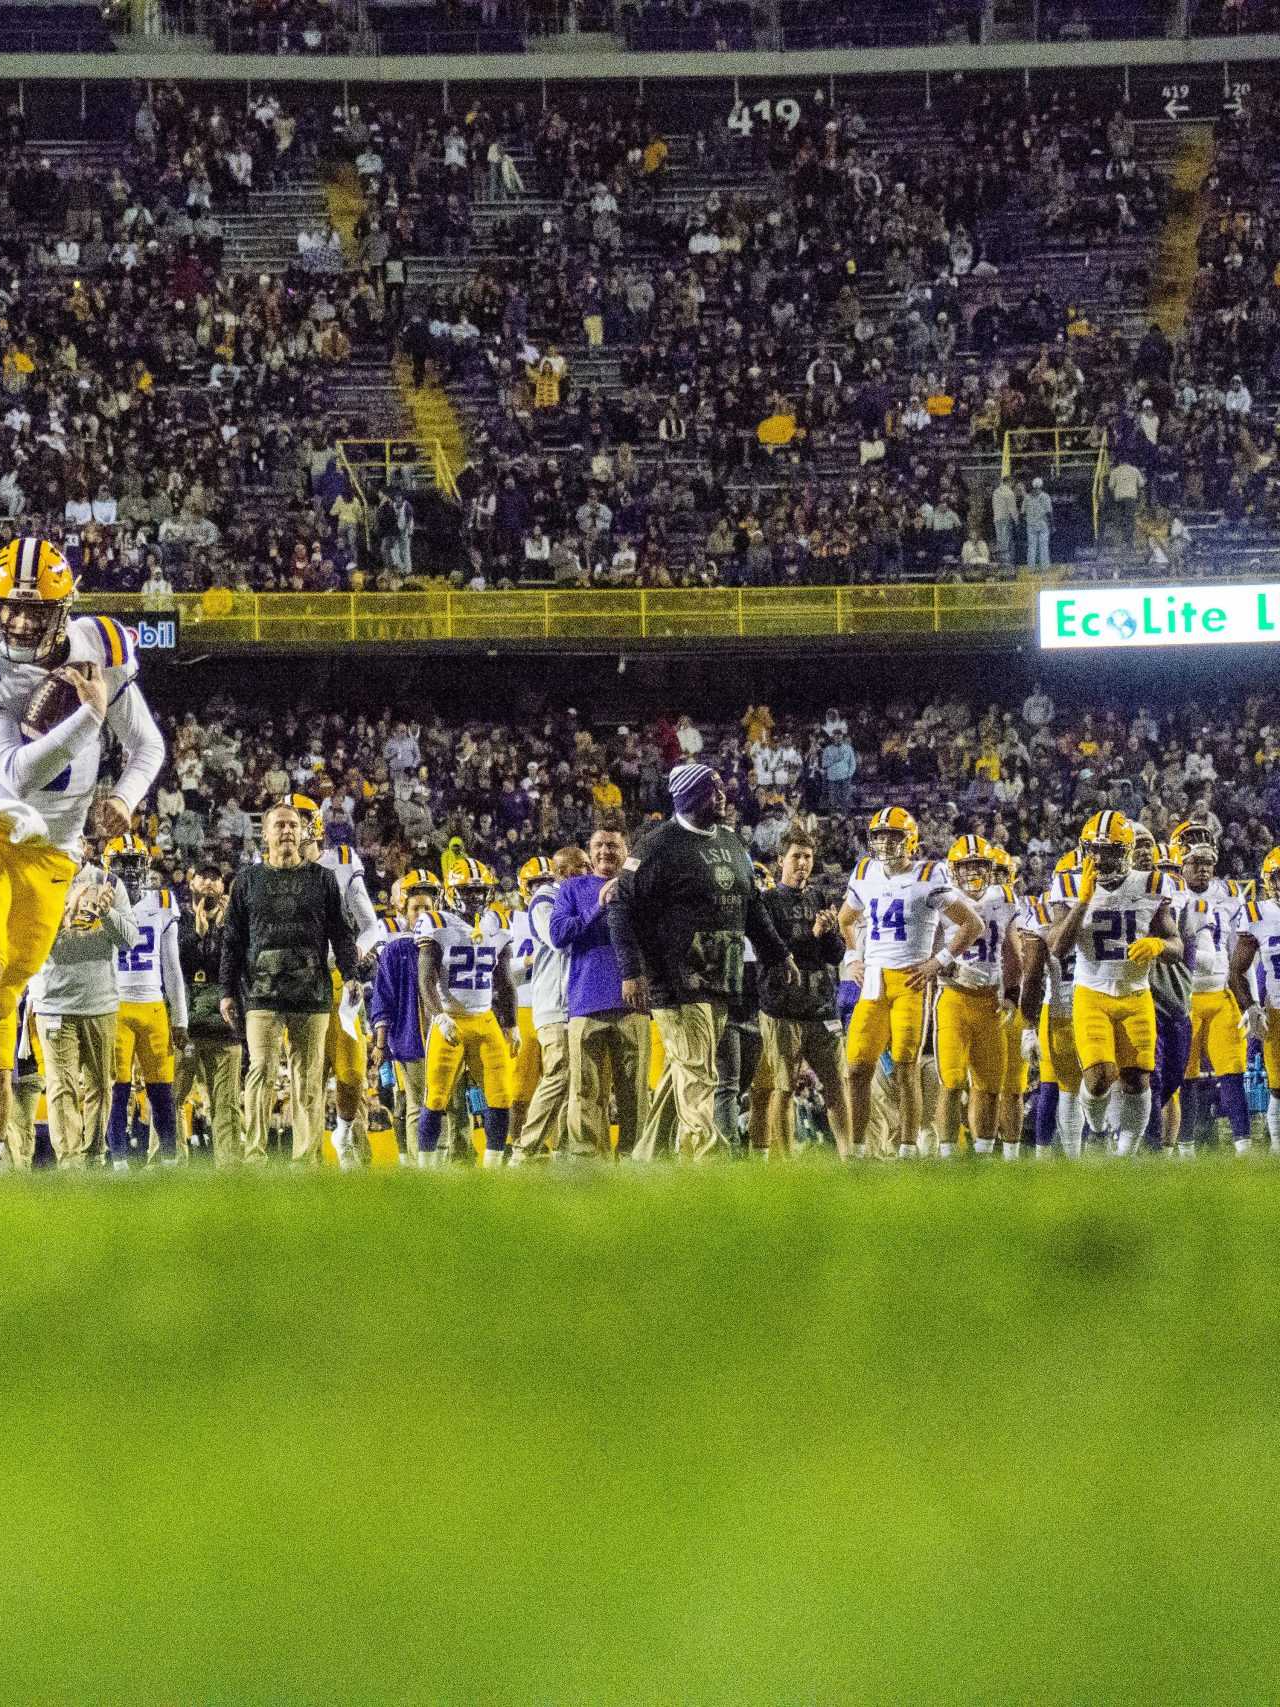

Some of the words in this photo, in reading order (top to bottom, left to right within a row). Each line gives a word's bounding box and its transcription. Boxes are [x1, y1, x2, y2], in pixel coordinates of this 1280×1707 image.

[728, 99, 800, 135] 419
[1257, 593, 1280, 631] L
[700, 848, 732, 864] LSU
[870, 898, 908, 941] 14
[1091, 910, 1137, 961] 21
[449, 946, 497, 990] 22
